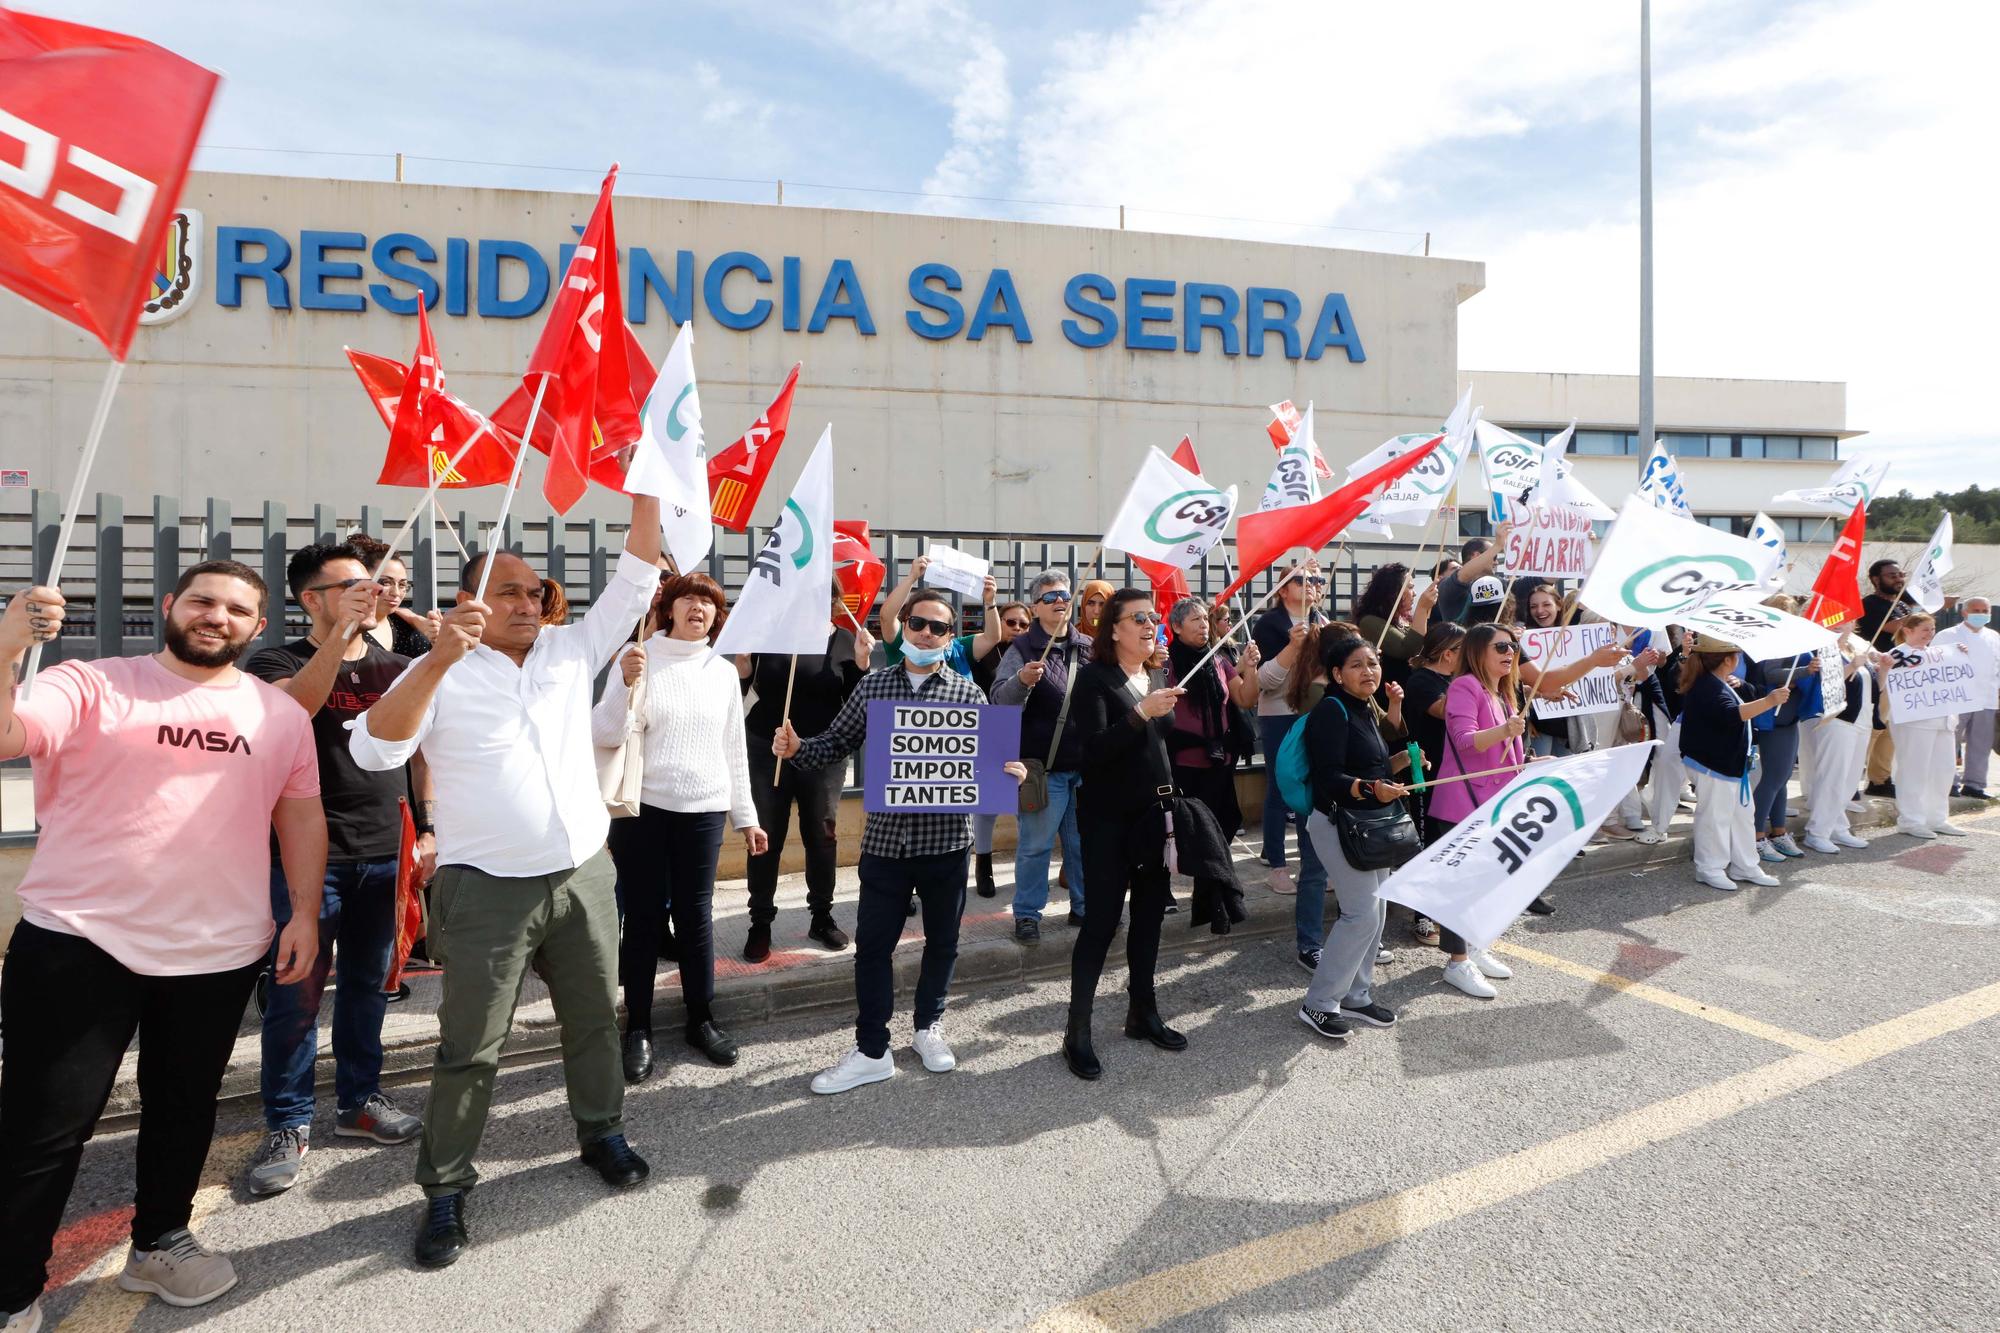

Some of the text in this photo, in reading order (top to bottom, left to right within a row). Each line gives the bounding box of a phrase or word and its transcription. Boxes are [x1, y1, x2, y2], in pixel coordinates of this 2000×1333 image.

[215, 224, 877, 337] RESIDNCIA
[905, 262, 1034, 344] SA
[1060, 272, 1367, 364] SERRA
[1493, 450, 1539, 471] CSIF
[1276, 458, 1311, 505] CSIF
[1527, 629, 1573, 661] STOP
[1887, 663, 1976, 694] PRECARIEDAD
[1903, 685, 1974, 710] SALARIAL
[896, 708, 977, 729] TODOS
[157, 725, 252, 756] NASA
[892, 735, 976, 755] SOMOS
[886, 786, 977, 805] TANTES
[1491, 795, 1558, 876] CSIF
[1446, 836, 1481, 868] ILLES
